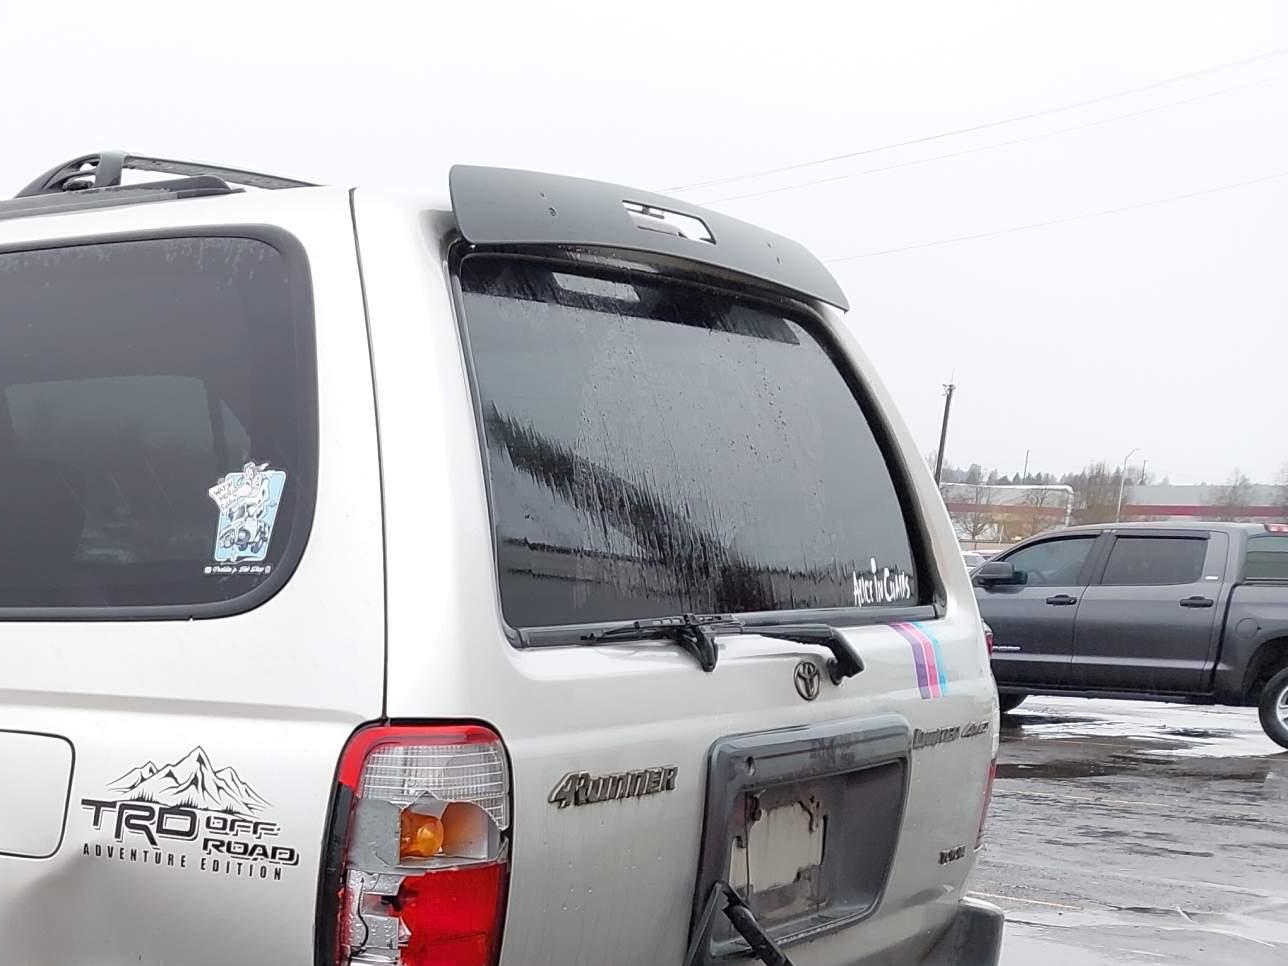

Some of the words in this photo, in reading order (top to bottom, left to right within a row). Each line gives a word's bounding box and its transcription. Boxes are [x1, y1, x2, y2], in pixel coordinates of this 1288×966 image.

[81, 798, 201, 850] TRD
[205, 815, 281, 840] OFF
[82, 842, 187, 869] ADVENTURE
[200, 858, 283, 882] EDITION
[202, 837, 300, 867] ROAD
